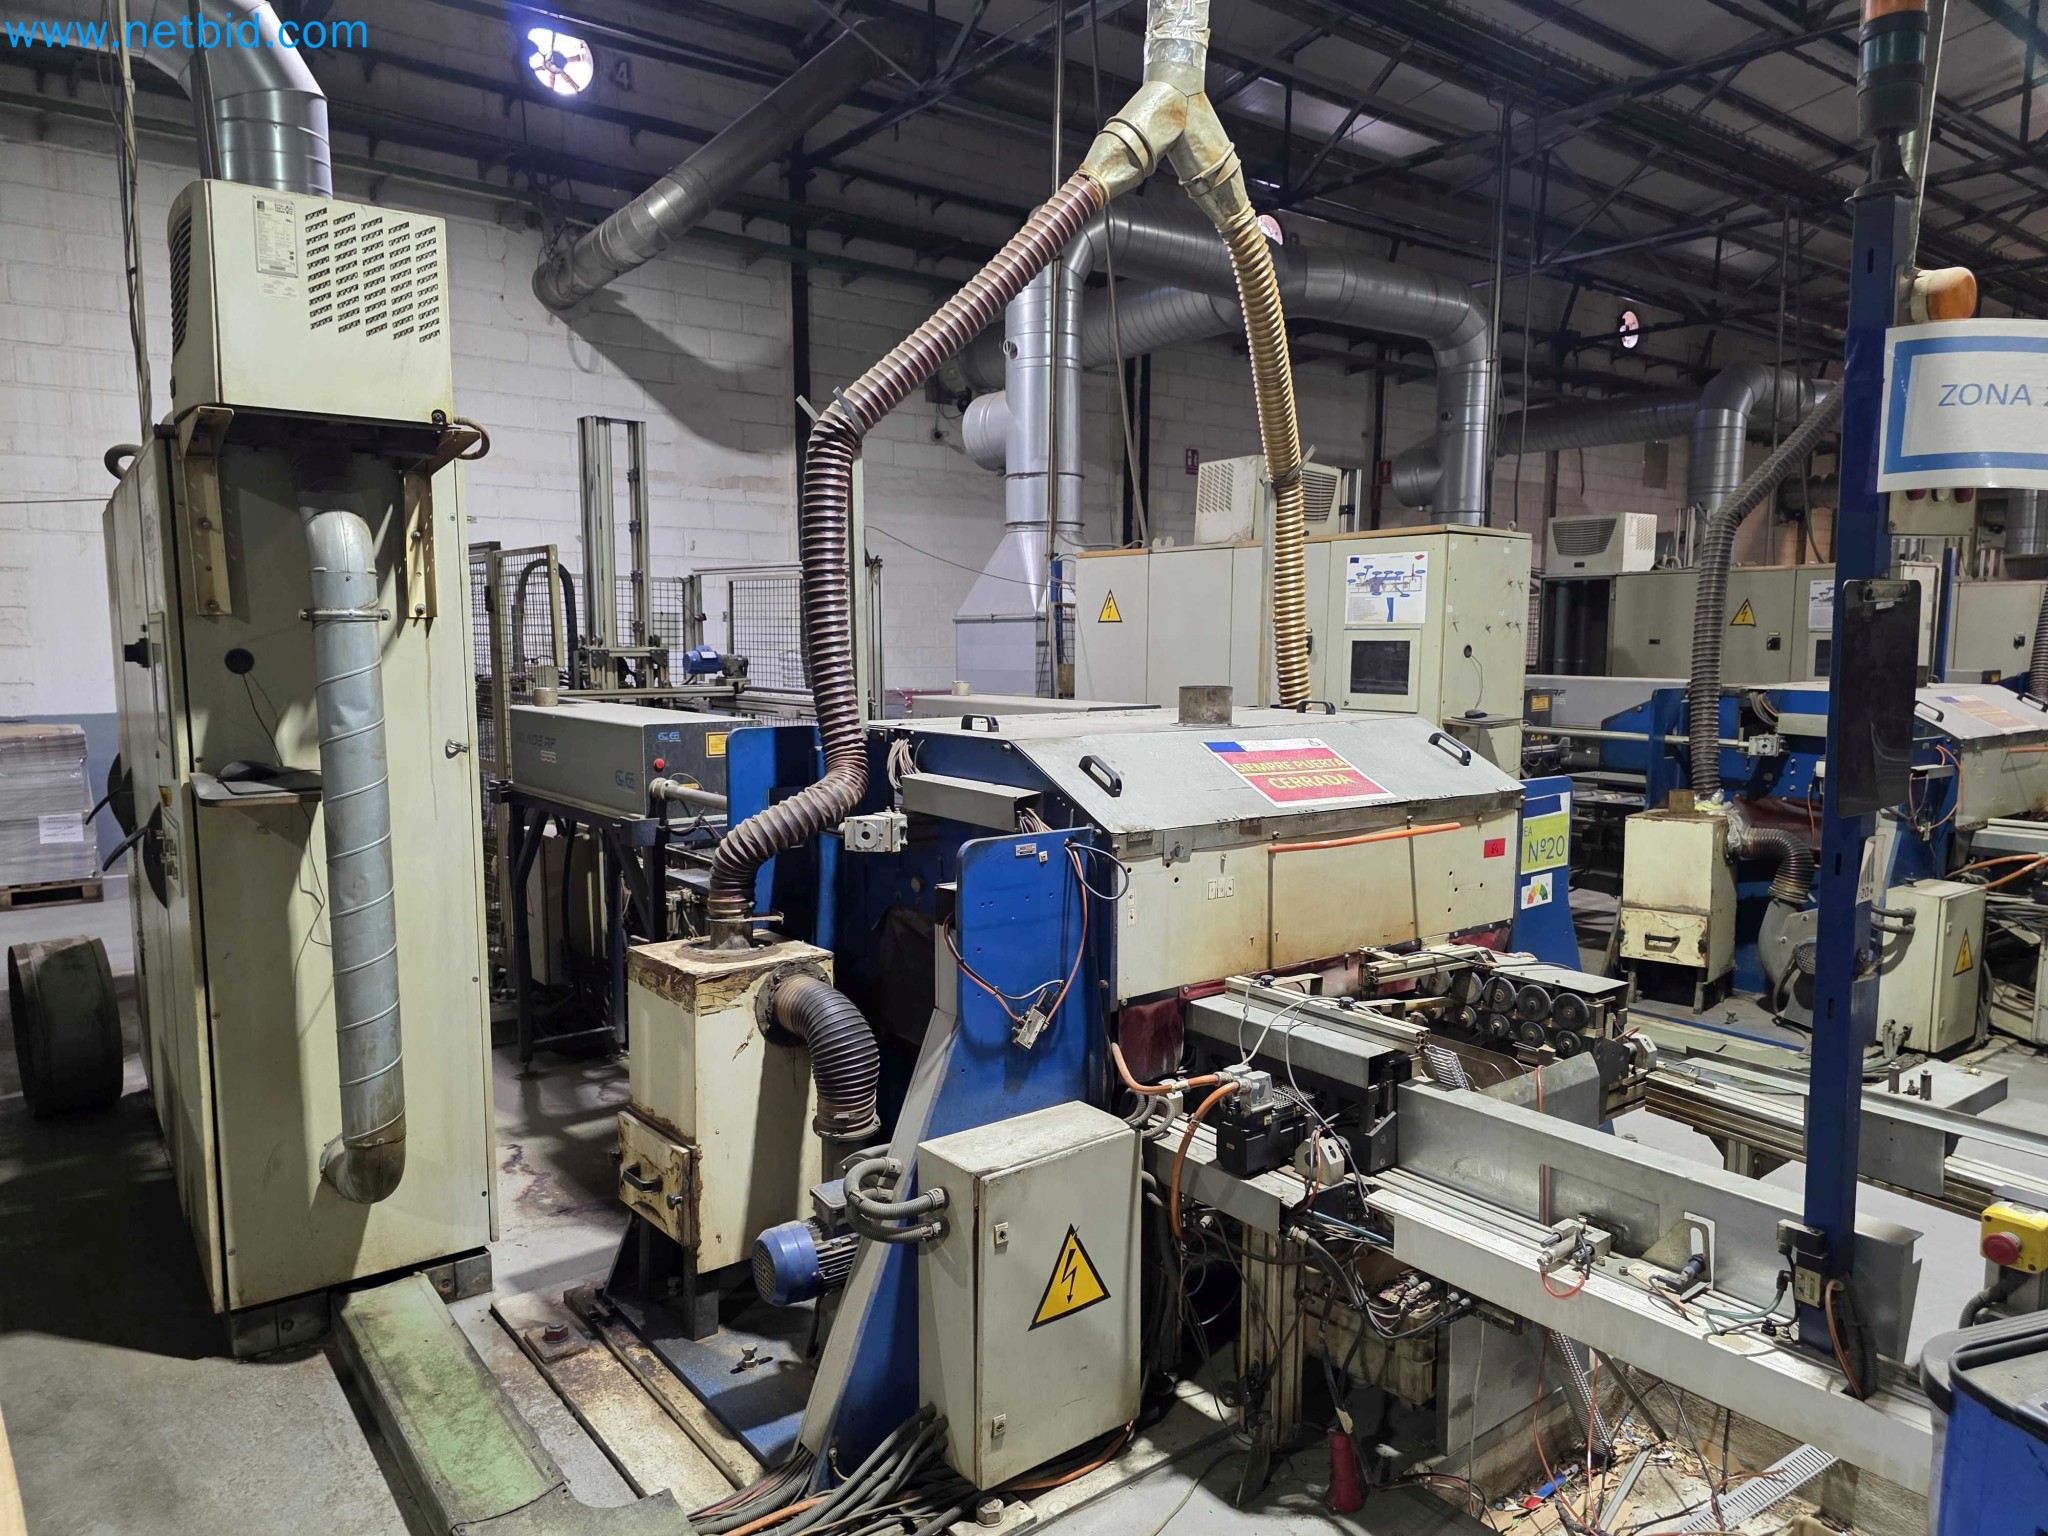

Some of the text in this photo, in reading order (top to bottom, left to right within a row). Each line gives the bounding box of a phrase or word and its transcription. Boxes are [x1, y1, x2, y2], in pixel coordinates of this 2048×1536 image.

[1938, 383, 2031, 406] ZONA
[1232, 758, 1348, 773] SIEMPRE PUERTA
[1268, 773, 1356, 789] CERRADA
[1528, 835, 1565, 863] Nº20
